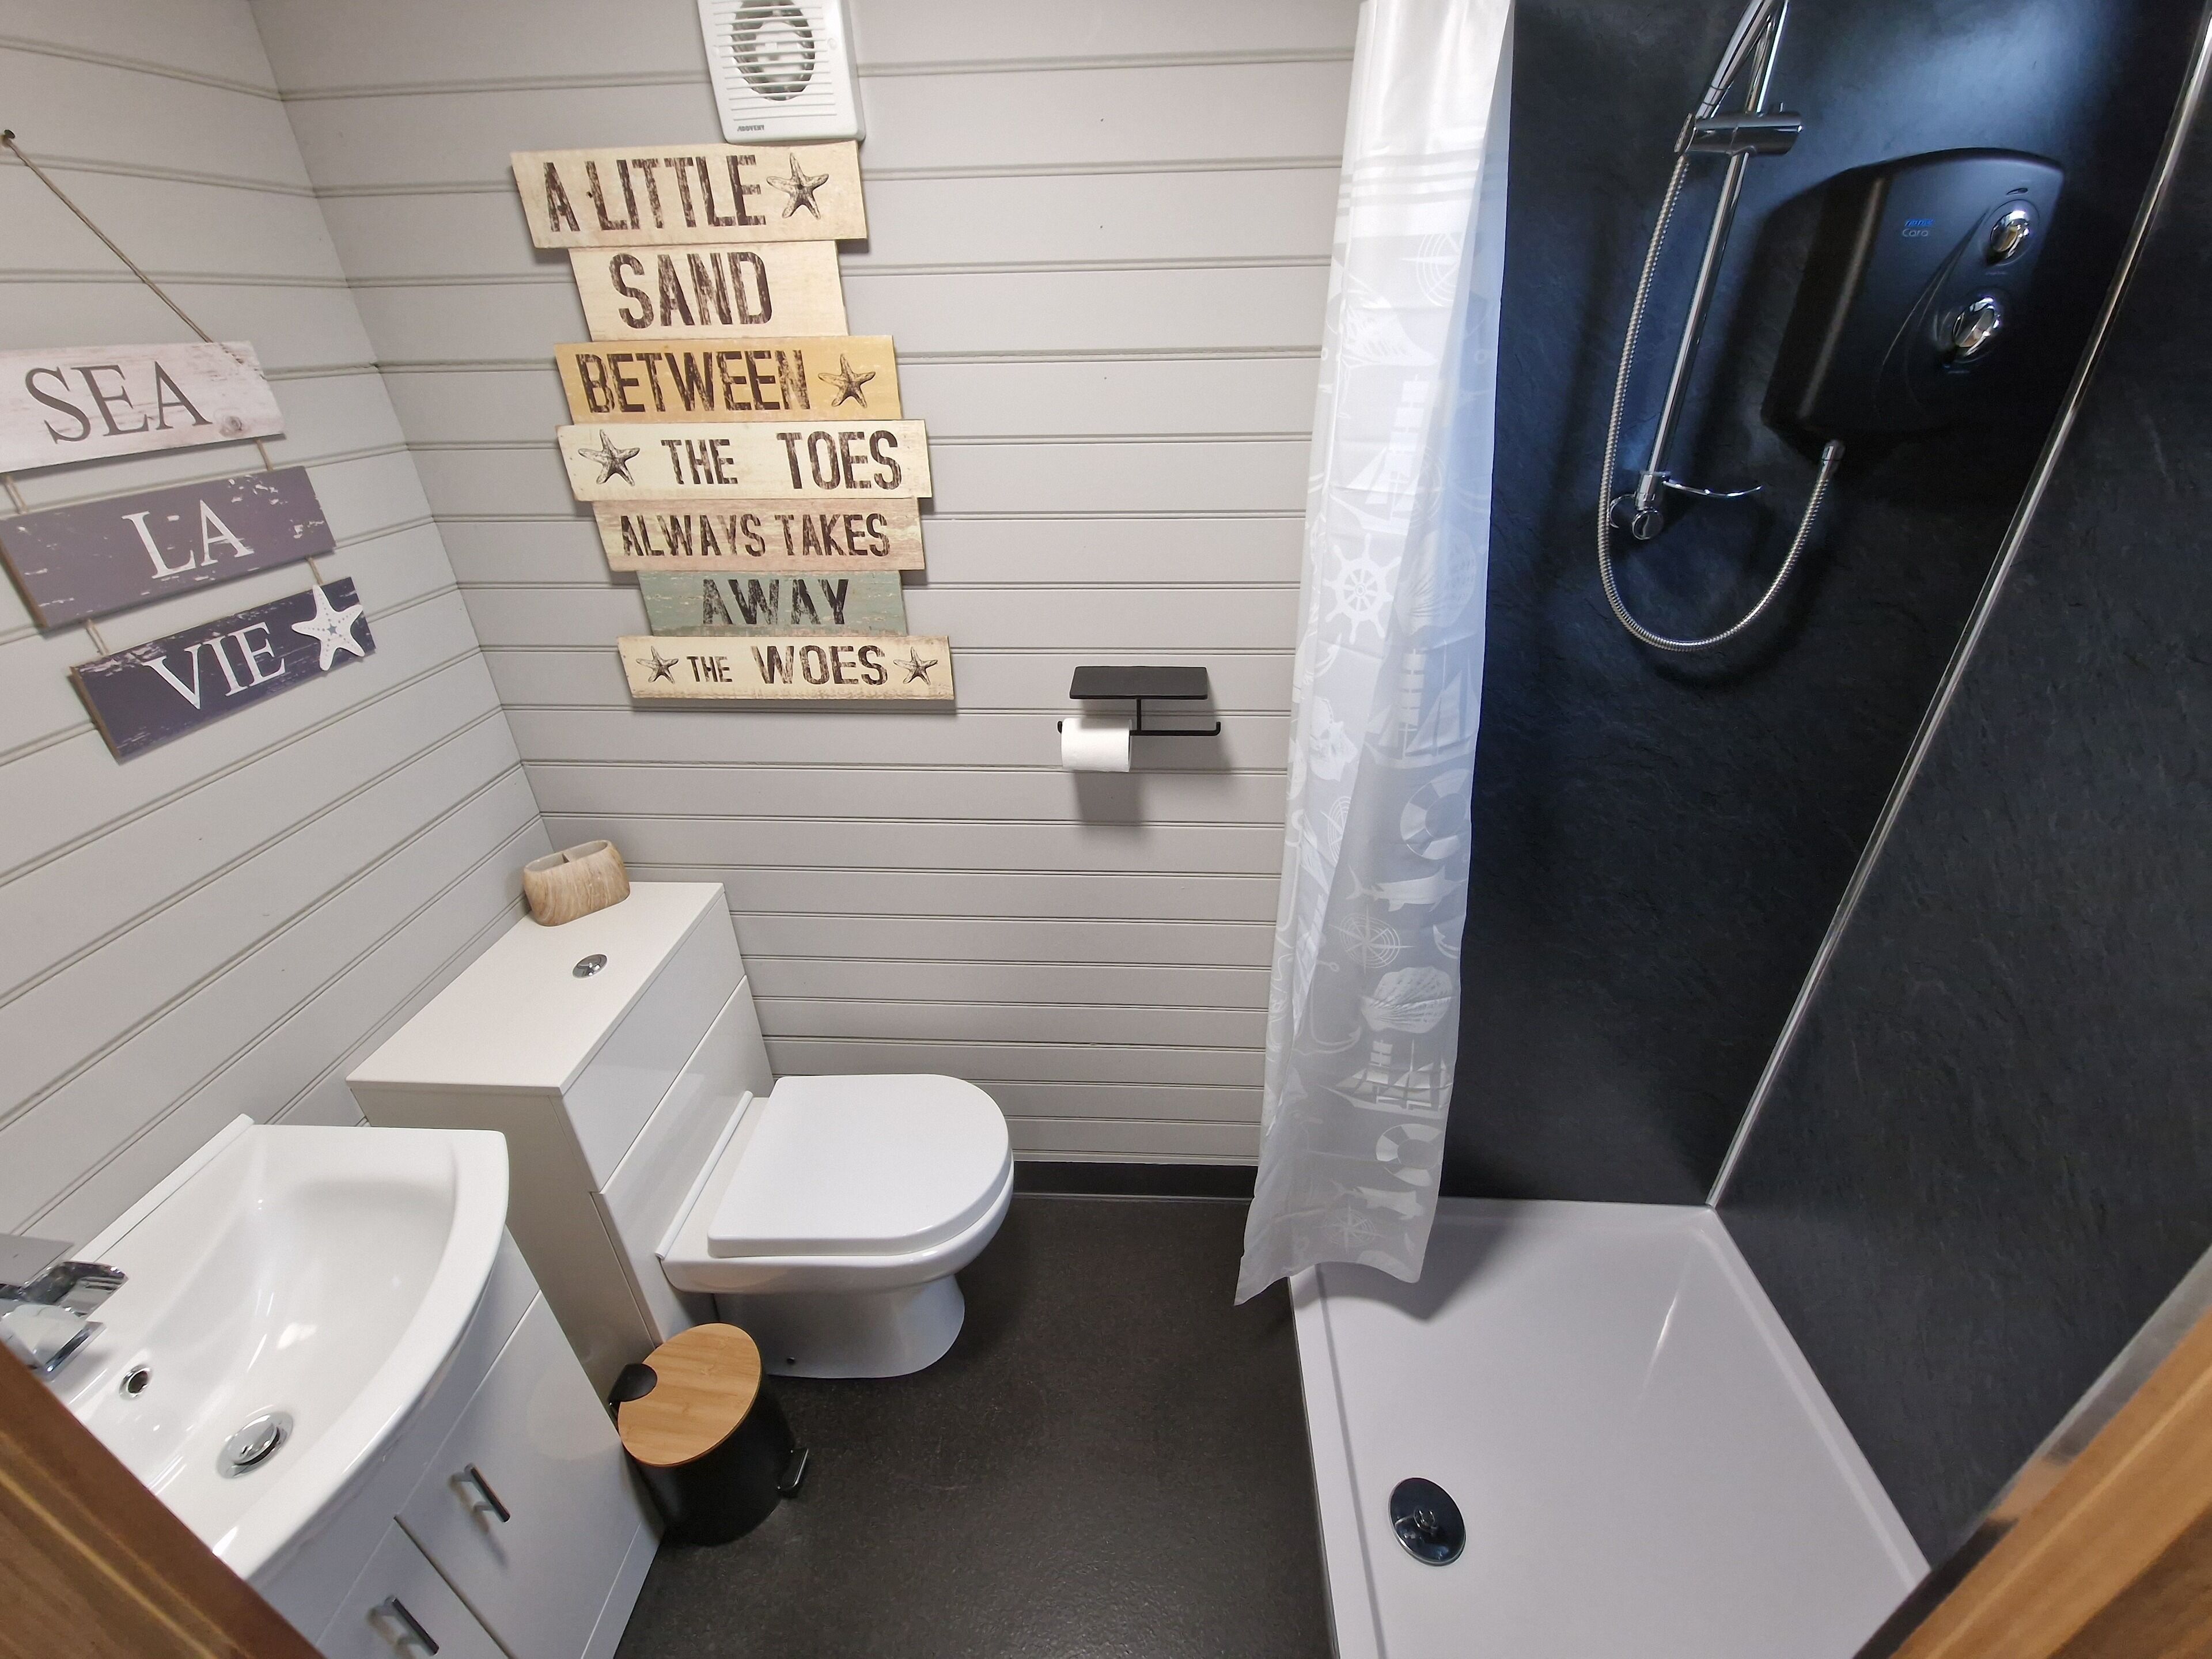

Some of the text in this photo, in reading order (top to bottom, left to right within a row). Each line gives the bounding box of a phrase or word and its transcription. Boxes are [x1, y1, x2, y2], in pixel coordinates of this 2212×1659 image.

[542, 154, 767, 232] A LITTLE
[609, 251, 772, 329] SAND
[25, 360, 213, 444] SEA
[575, 349, 810, 413] BETWEEN
[661, 430, 902, 490] THE TOES
[122, 499, 255, 579] LA
[620, 513, 891, 557] ALWAYS TAKES
[702, 579, 849, 625] AWAY
[143, 622, 286, 710] VIE
[687, 645, 889, 685] THE WOES
